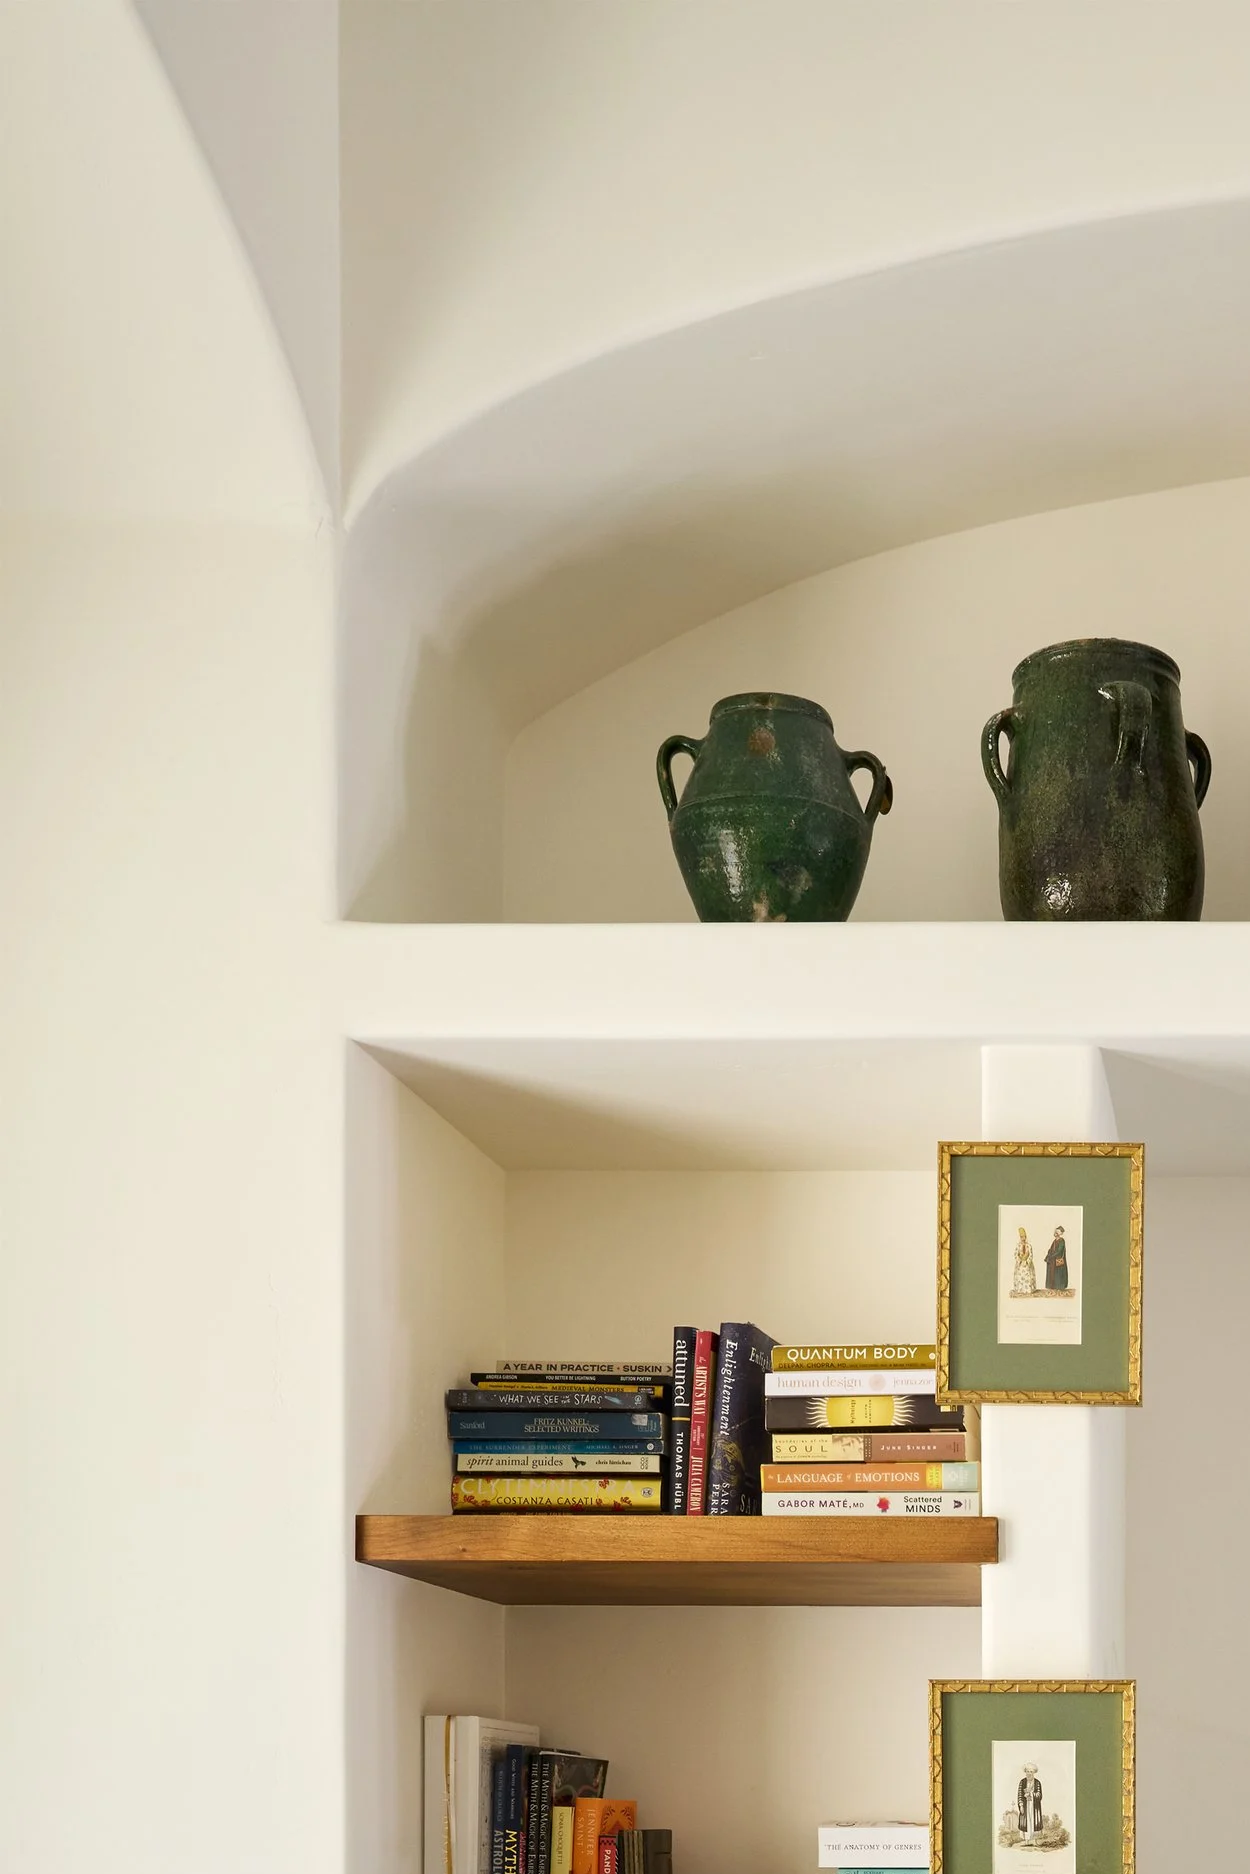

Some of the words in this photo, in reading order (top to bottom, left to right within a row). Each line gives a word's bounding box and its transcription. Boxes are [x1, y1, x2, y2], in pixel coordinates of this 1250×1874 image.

[787, 1348, 867, 1362] QUANTUM
[874, 1347, 918, 1359] BODY
[513, 1364, 542, 1372] YEAR
[546, 1364, 558, 1372] IN
[561, 1364, 613, 1372] PRACTICE
[623, 1365, 662, 1373] SUSKIN
[674, 1340, 689, 1407] attuned
[720, 1339, 738, 1436] Enlightenment
[694, 1400, 705, 1416] WAY
[524, 1425, 558, 1433] SELECTED
[675, 1432, 683, 1478] THOMAS
[775, 1445, 828, 1453] SOUL
[467, 1456, 493, 1468] spirit
[495, 1457, 529, 1467] animal
[532, 1457, 563, 1469] guides
[691, 1456, 703, 1476] JULIA
[777, 1473, 843, 1483] LANGUAGE
[855, 1472, 920, 1482] EMOTIONS
[461, 1478, 637, 1496] CLYTEMNESTRA
[690, 1478, 702, 1511] CAMERON
[496, 1497, 552, 1505] COSTANZA
[557, 1497, 593, 1505] CASATI
[675, 1483, 684, 1509] HÜBL
[778, 1500, 815, 1508] GABOR
[906, 1505, 941, 1513] MINDS
